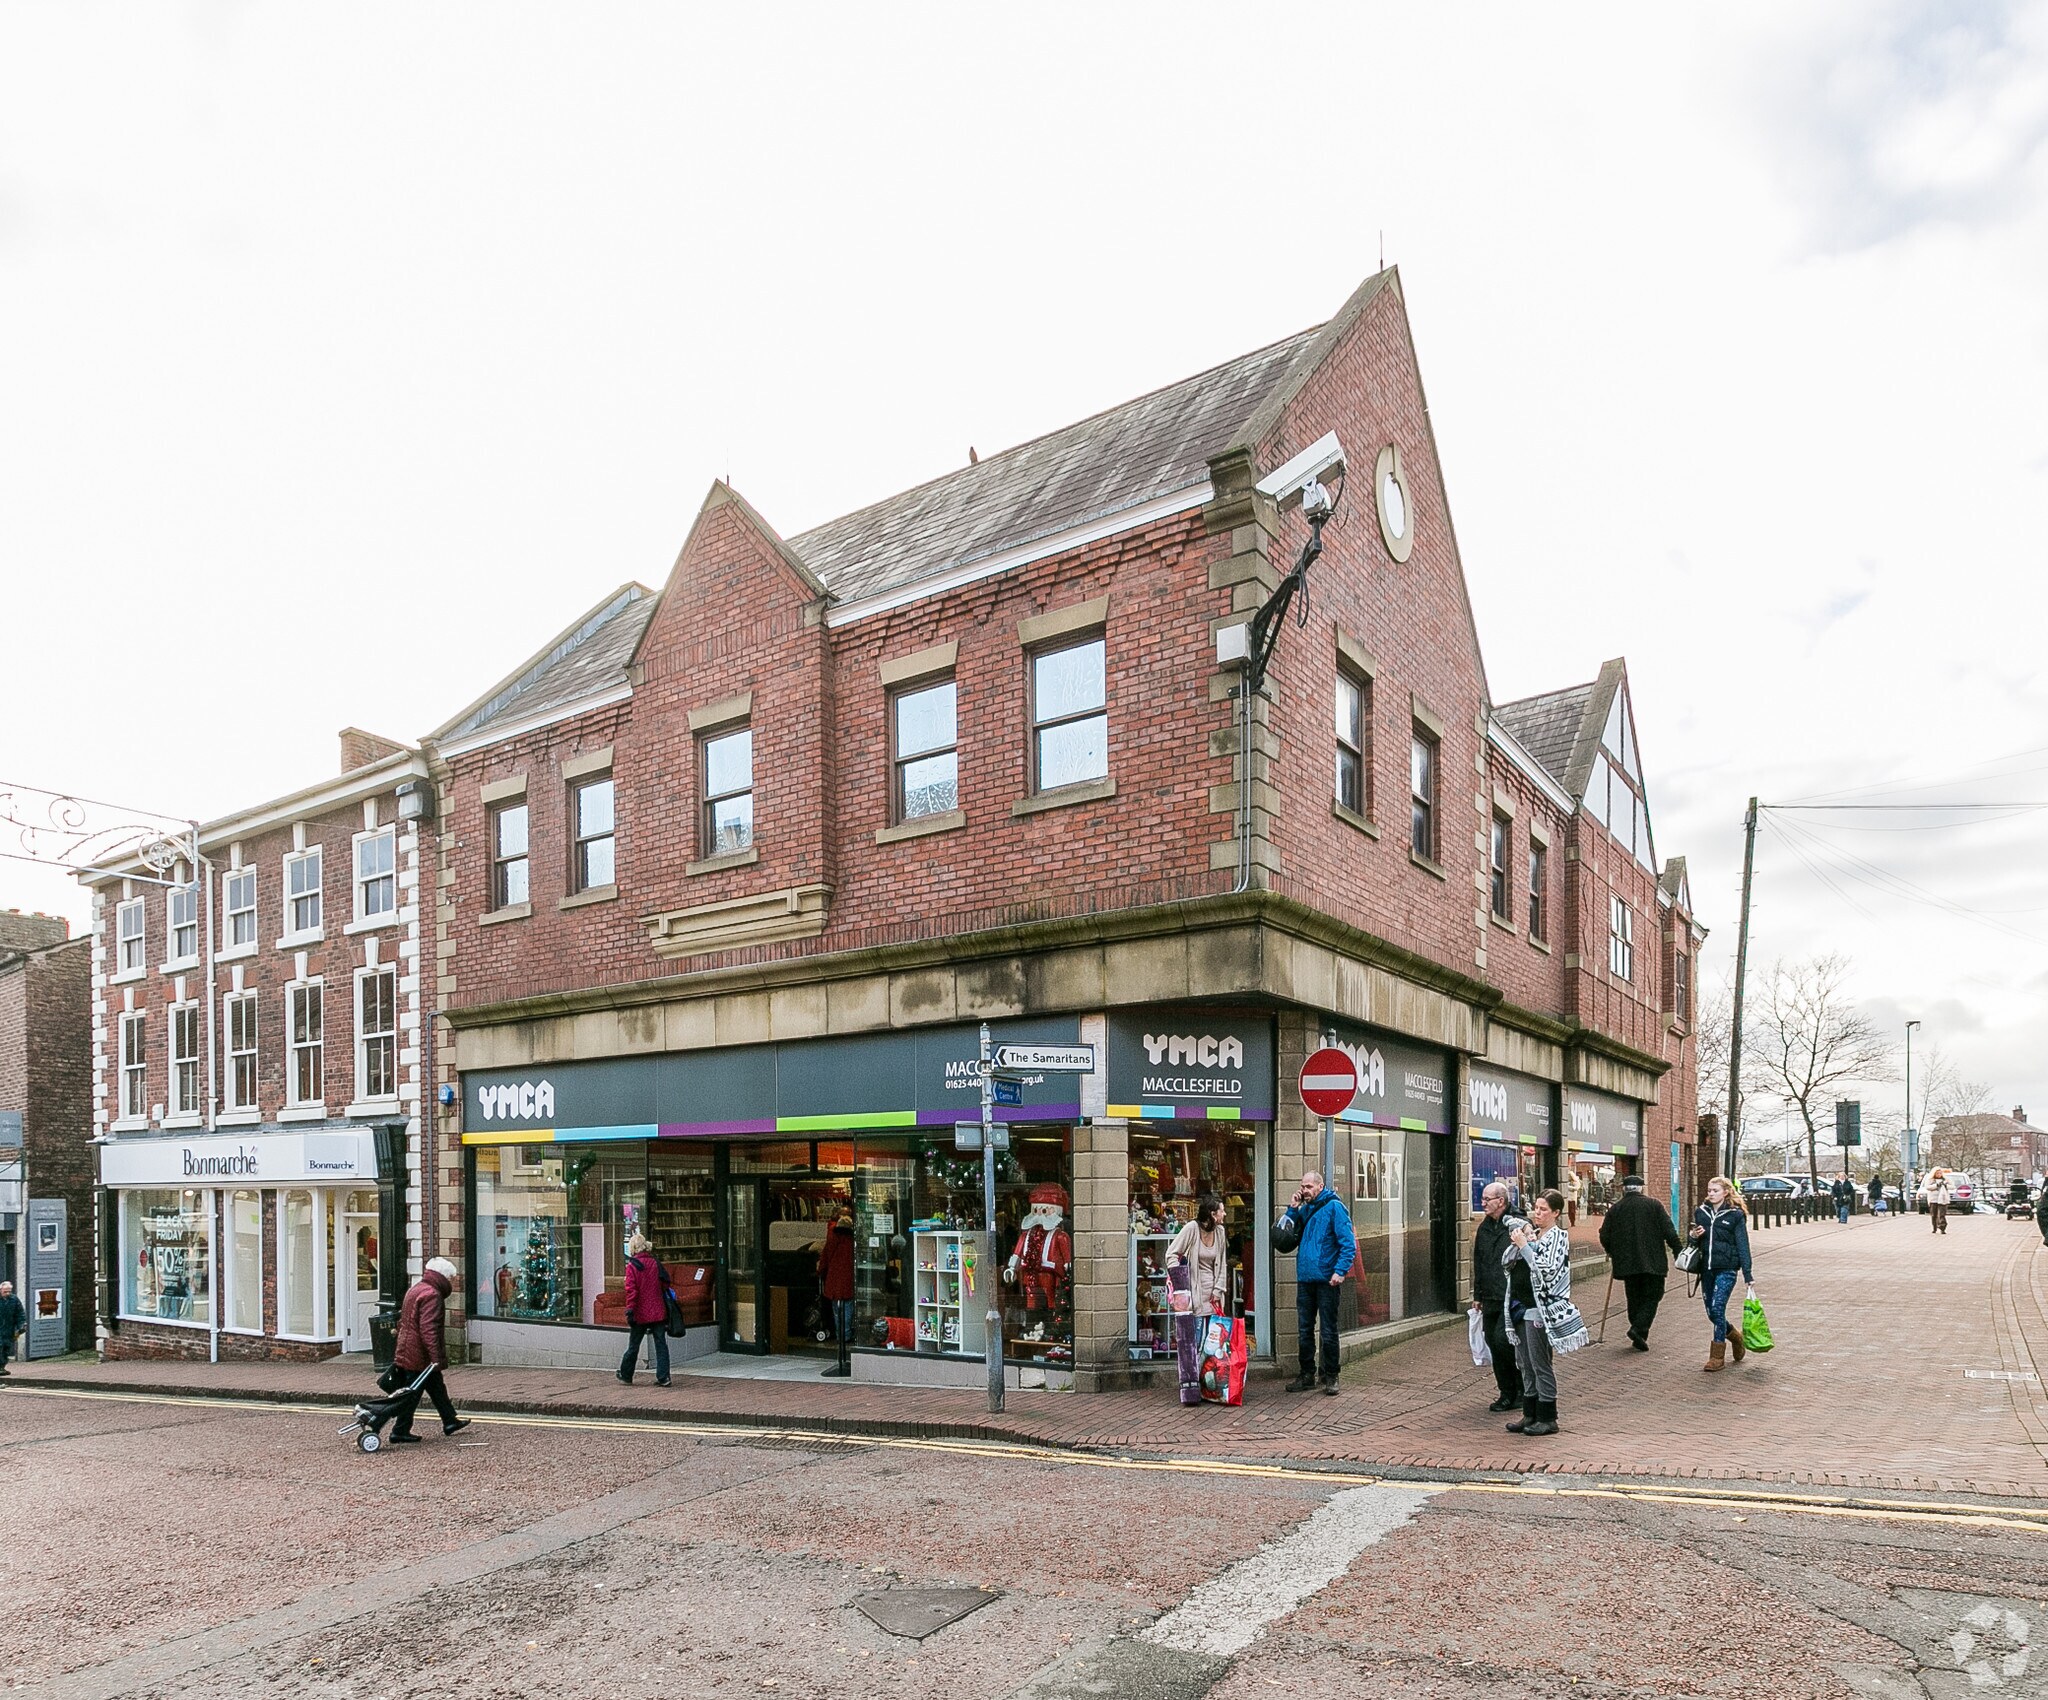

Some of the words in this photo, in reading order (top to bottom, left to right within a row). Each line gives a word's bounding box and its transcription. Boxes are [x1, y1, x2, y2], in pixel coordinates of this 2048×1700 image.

[1009, 1052, 1029, 1063] The
[1032, 1053, 1091, 1064] Samaritans
[1143, 1033, 1243, 1069] YMCA
[945, 1079, 967, 1089] 01625
[967, 1078, 983, 1088] 440
[1142, 1077, 1242, 1093] MACCLESFIELD
[478, 1079, 555, 1121] YMCA
[1469, 1078, 1508, 1122] YMCA
[1571, 1101, 1597, 1135] YMCA
[182, 1145, 258, 1177] Bonmarché
[309, 1159, 355, 1170] Bonmarché
[156, 1215, 184, 1228] BLACK
[156, 1229, 183, 1241] FRIDAY
[157, 1247, 183, 1274] 50%
